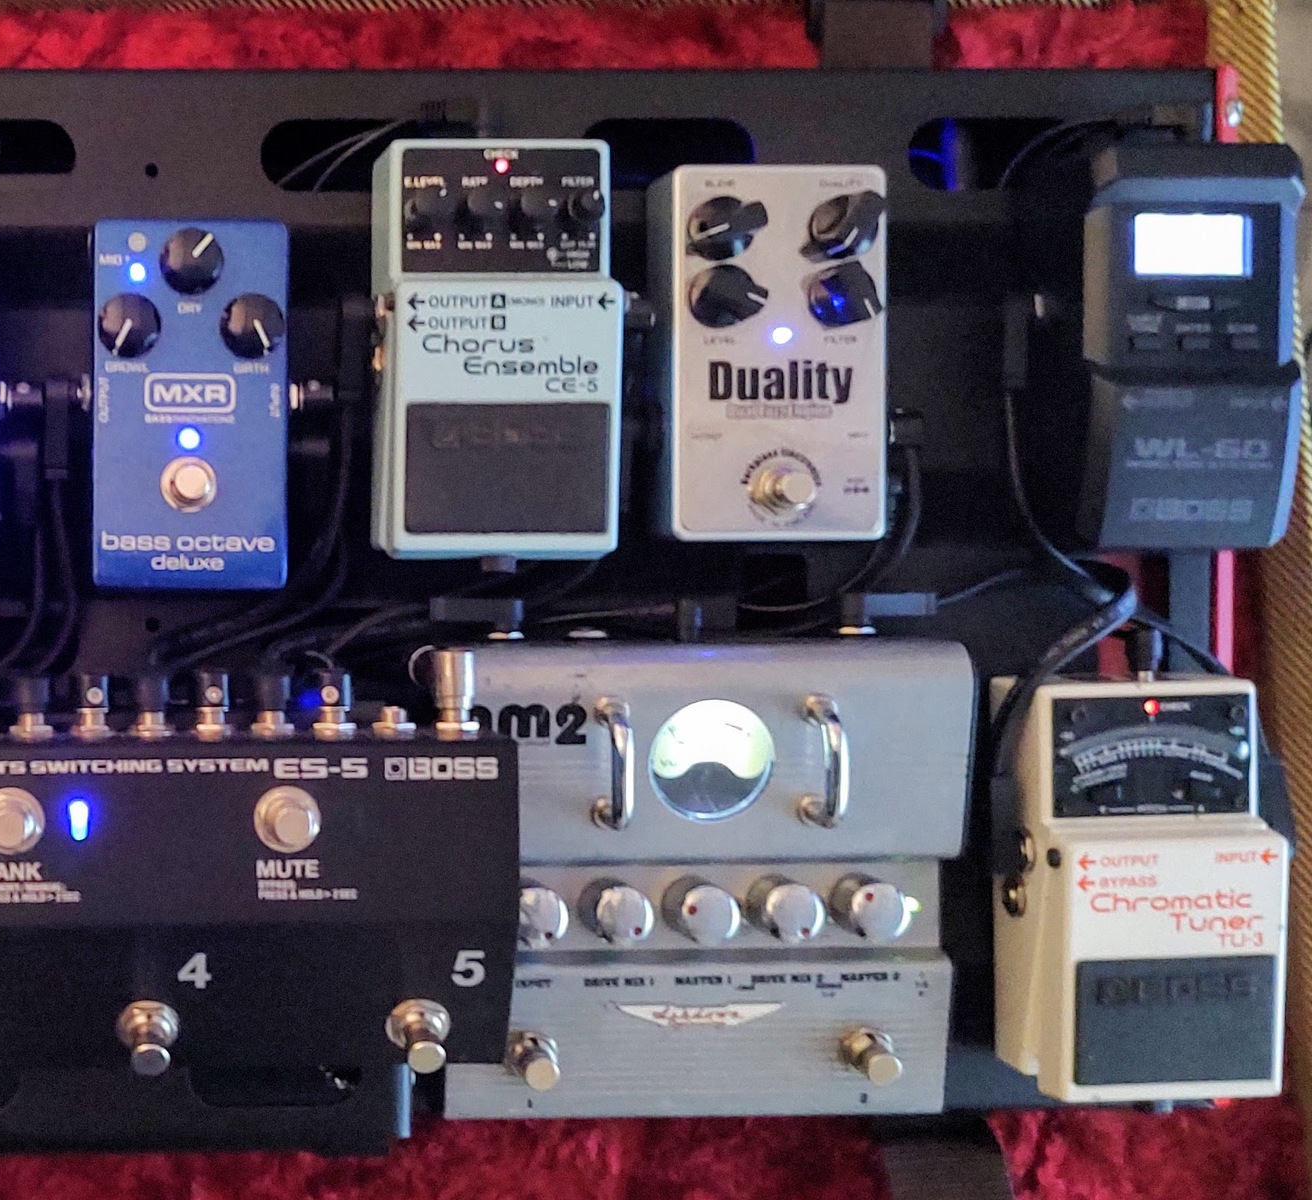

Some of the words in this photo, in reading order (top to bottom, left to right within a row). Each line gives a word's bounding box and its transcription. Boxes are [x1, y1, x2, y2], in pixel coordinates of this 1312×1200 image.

[561, 176, 595, 187] FILTER
[428, 294, 488, 309] OUTPUT
[550, 295, 594, 308] INPUT
[428, 315, 488, 329] OUTPUT
[422, 334, 535, 354] Chorus
[464, 355, 599, 375] Ensemble
[545, 378, 599, 393] CE-5
[709, 360, 853, 404] Duality
[153, 384, 227, 404] MXR
[101, 531, 172, 550] bass
[176, 533, 276, 552] octave
[151, 553, 225, 571] deluxe
[30, 758, 163, 775] SWITCHING
[167, 757, 269, 773] SYSTEM
[273, 757, 369, 779] ES-5
[408, 757, 499, 781] BOSS
[1099, 854, 1159, 868] OUTPUT
[1215, 851, 1257, 864] INPUT
[256, 859, 320, 879] MUTE
[1098, 875, 1158, 888] BYPASS
[1090, 886, 1253, 914] Chromatic
[1170, 912, 1264, 932] Tuner
[1219, 933, 1264, 947] TU-3
[177, 952, 213, 989] 4
[451, 949, 486, 987] 5
[675, 975, 722, 986] MASTER
[840, 972, 889, 983] MASTER
